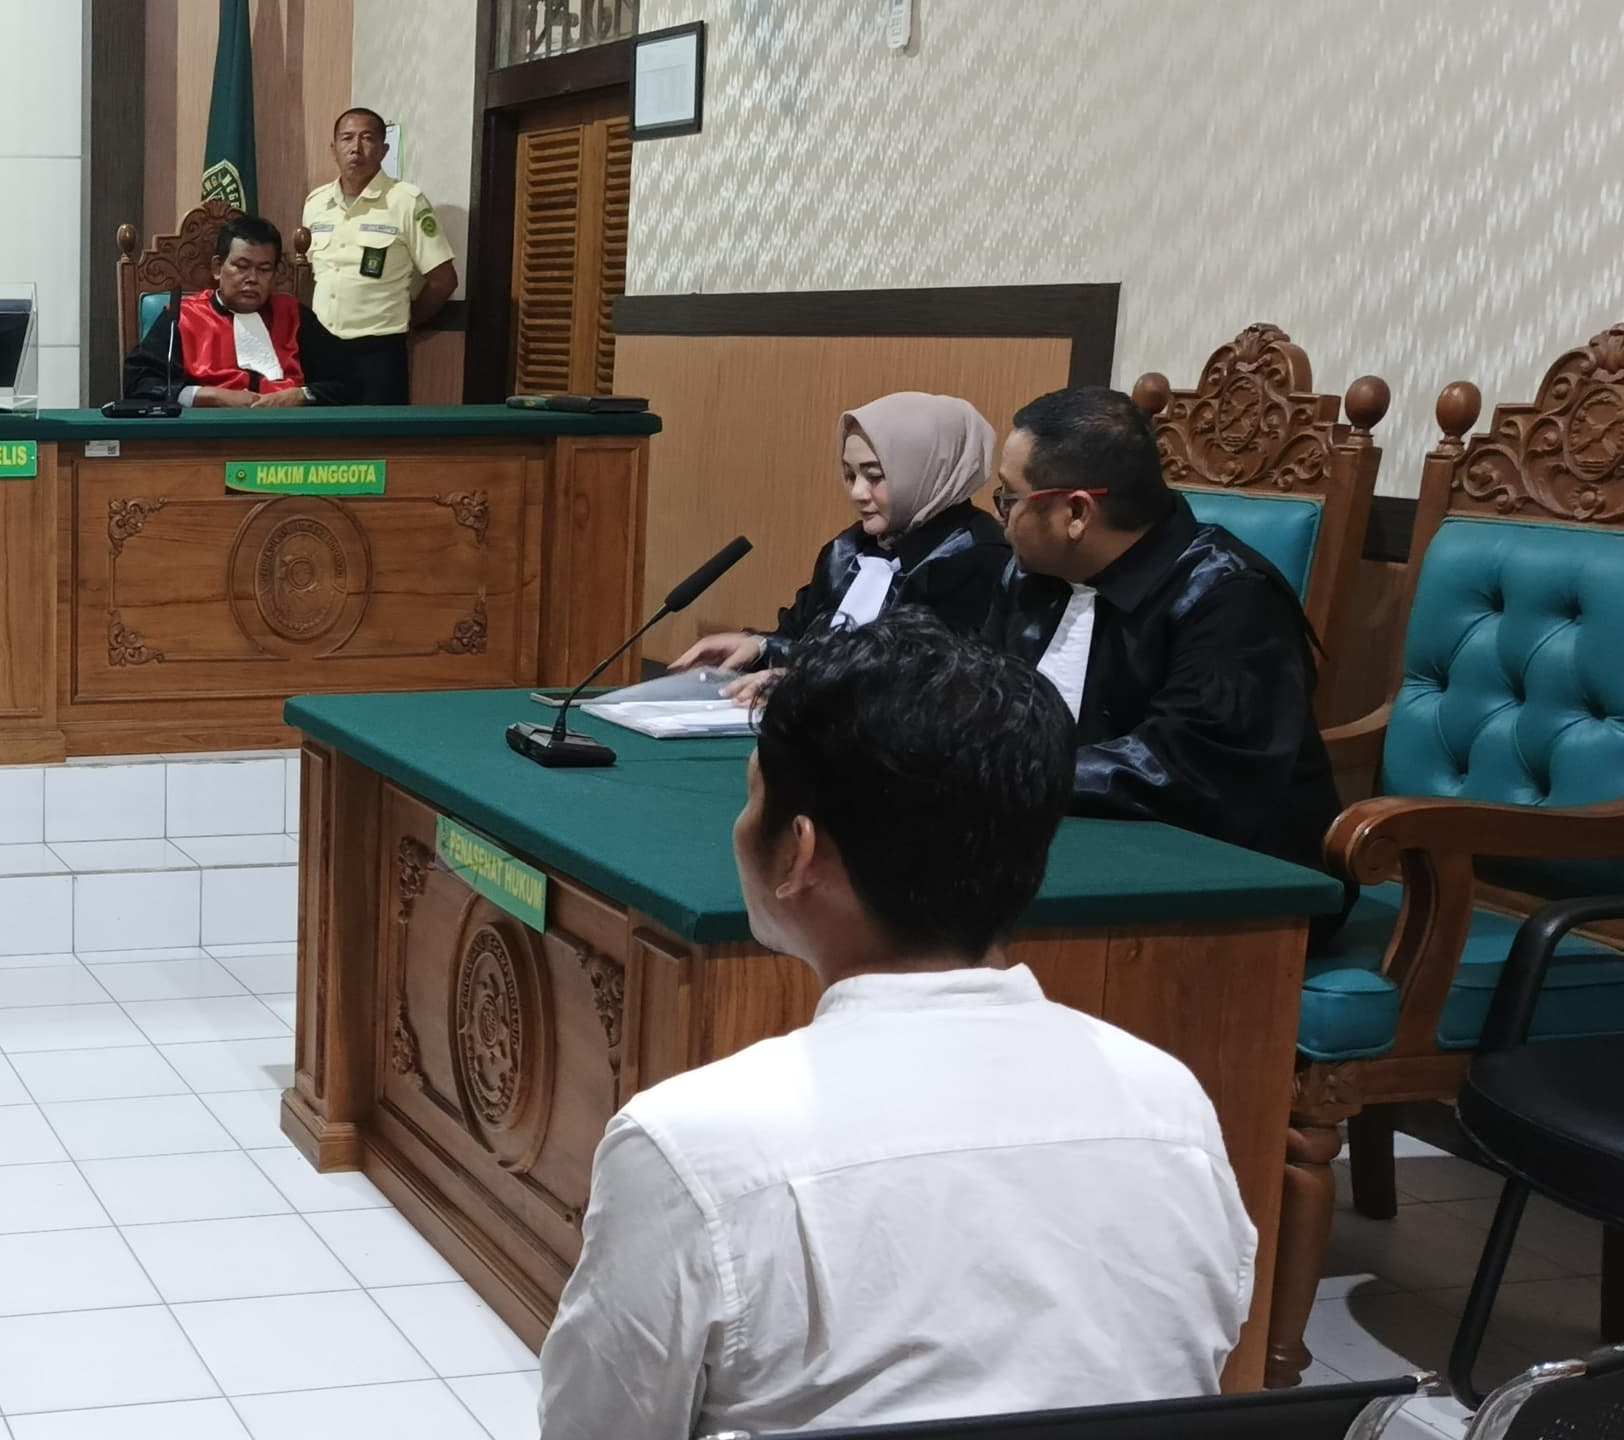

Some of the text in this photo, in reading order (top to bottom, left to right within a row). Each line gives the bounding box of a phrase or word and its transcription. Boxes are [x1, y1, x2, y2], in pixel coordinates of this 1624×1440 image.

[256, 464, 376, 485] HAKIM ANGGOTA
[504, 862, 543, 909] HUKUM
